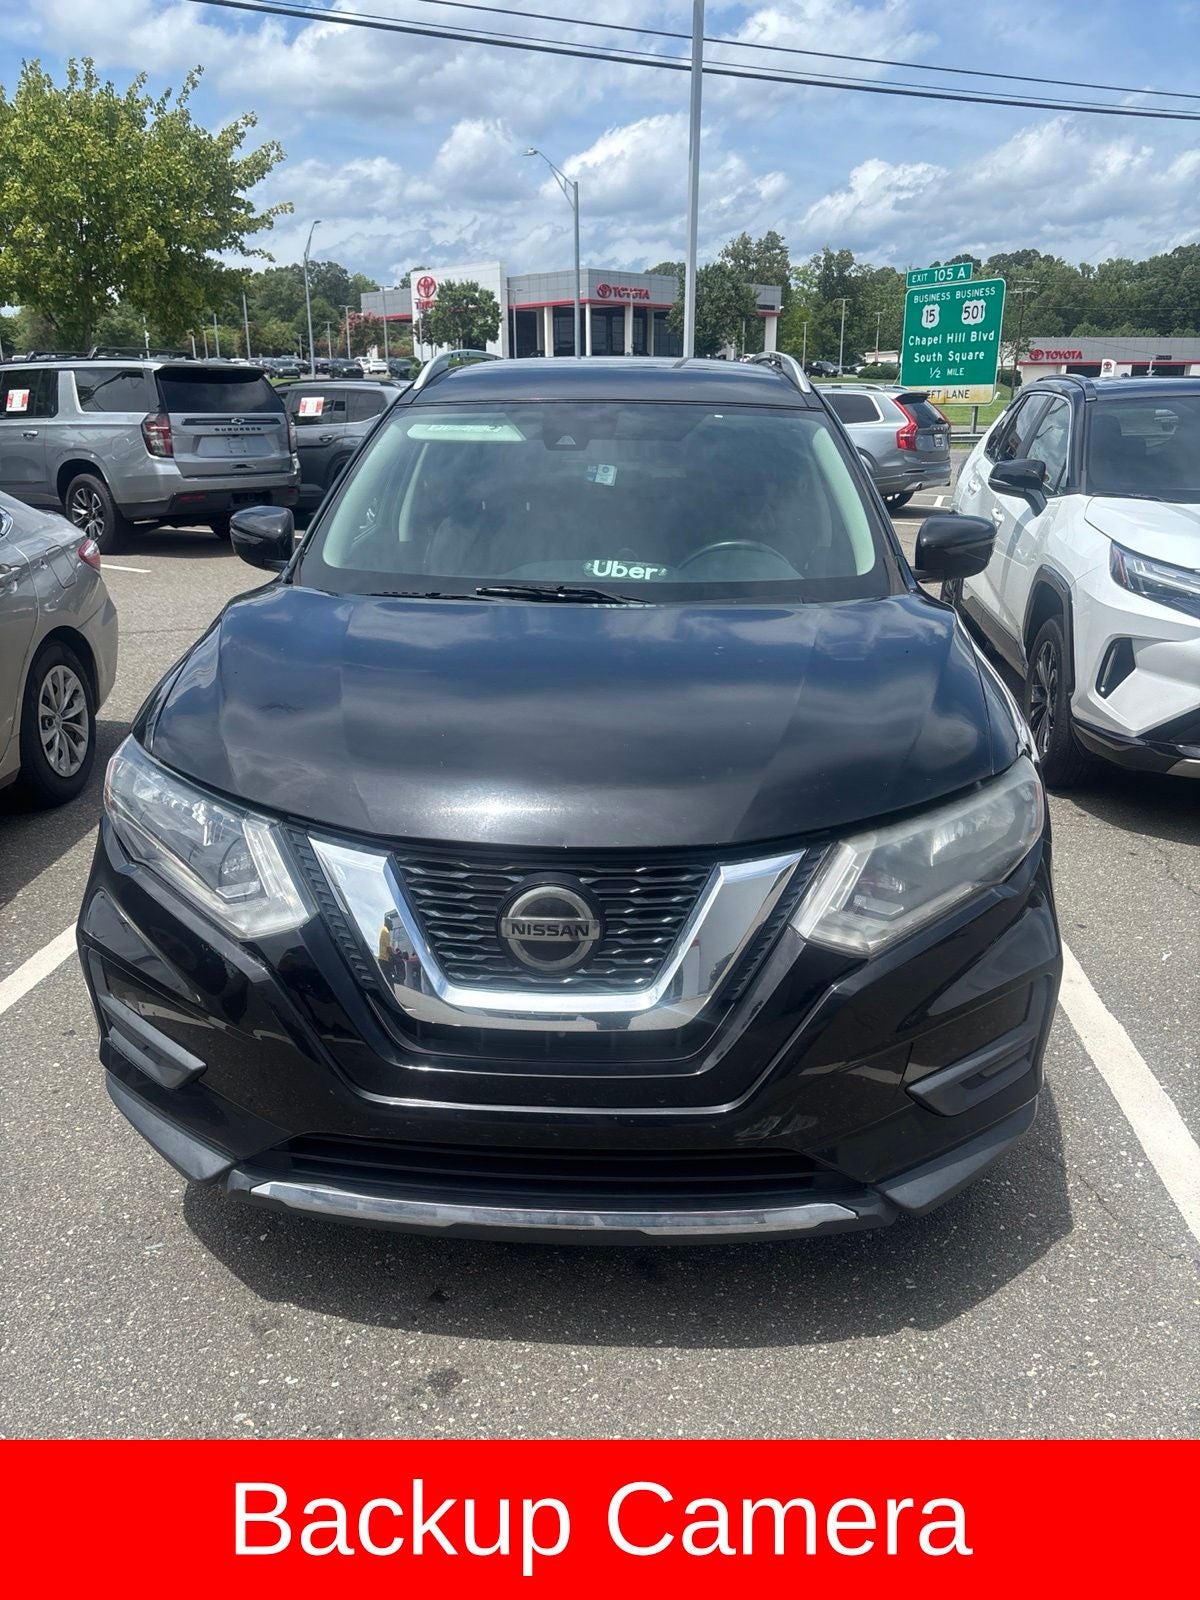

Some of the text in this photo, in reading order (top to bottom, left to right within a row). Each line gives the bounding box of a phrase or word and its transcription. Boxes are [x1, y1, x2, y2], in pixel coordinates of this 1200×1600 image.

[912, 267, 966, 283] EXIT 105 A
[913, 287, 996, 303] BUSINESS BUSINESS
[925, 304, 985, 323] 15 501
[908, 330, 995, 347] Chapel Hill Blvd
[913, 350, 985, 364] South Square
[1045, 350, 1083, 360] TOYOTA
[946, 368, 965, 376] MILE
[946, 389, 970, 399] LANE
[592, 559, 659, 580] Uber
[511, 923, 590, 937] NISSAN
